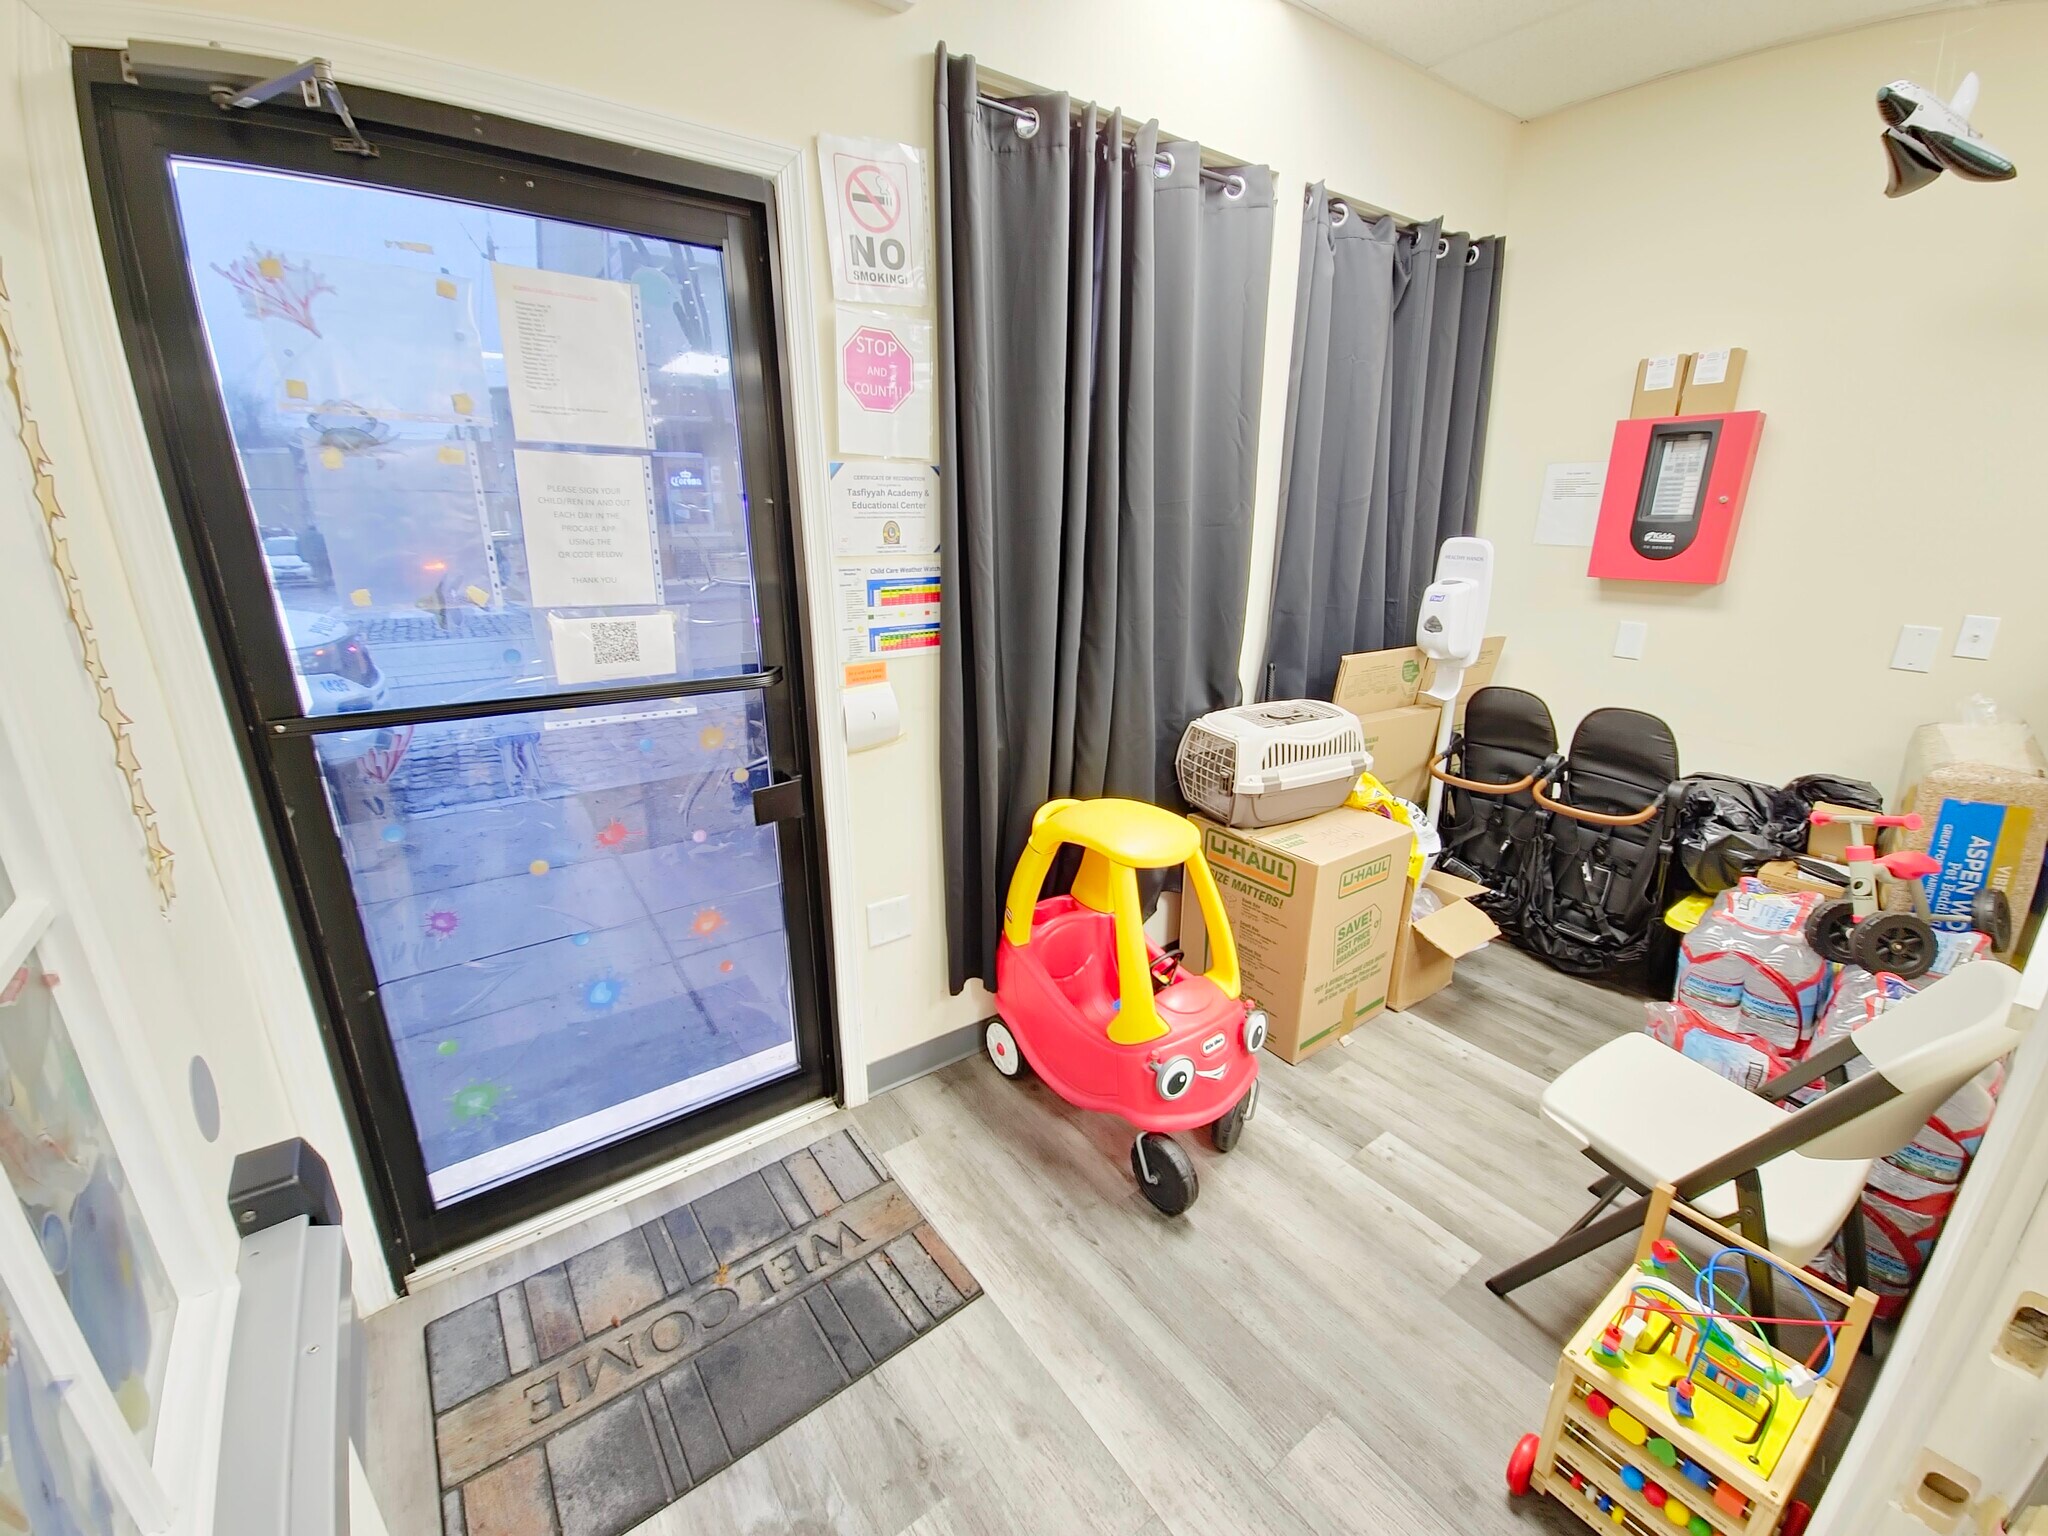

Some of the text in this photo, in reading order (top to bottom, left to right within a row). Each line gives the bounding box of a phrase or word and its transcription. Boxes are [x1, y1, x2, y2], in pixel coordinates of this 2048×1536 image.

[849, 234, 906, 271] NO
[853, 270, 909, 285] SMOKING!
[856, 336, 898, 358] STOP
[867, 366, 888, 377] AND
[546, 484, 621, 495] PLEASE SIGN YOUR
[847, 488, 930, 500] Tasfiyyah Academy &
[585, 498, 595, 506] IN
[597, 499, 614, 507] AND
[615, 499, 632, 507] OUT
[851, 501, 927, 510] Educational Center
[553, 511, 621, 520] EACH DAY IN THE
[561, 524, 600, 533] PROCARE
[568, 538, 612, 546] USING THE
[557, 551, 624, 559] QR CODE BELOW
[900, 566, 923, 574] Weather
[600, 576, 618, 584] YOU
[1956, 835, 1992, 895] ASPEN
[1343, 861, 1388, 887] U-HAUL
[1945, 862, 1963, 881] Pet
[1231, 879, 1284, 909] MATTERS!
[1338, 910, 1373, 941] SAVE!
[1336, 941, 1352, 957] BEST
[523, 1220, 869, 1425] WELCOME
